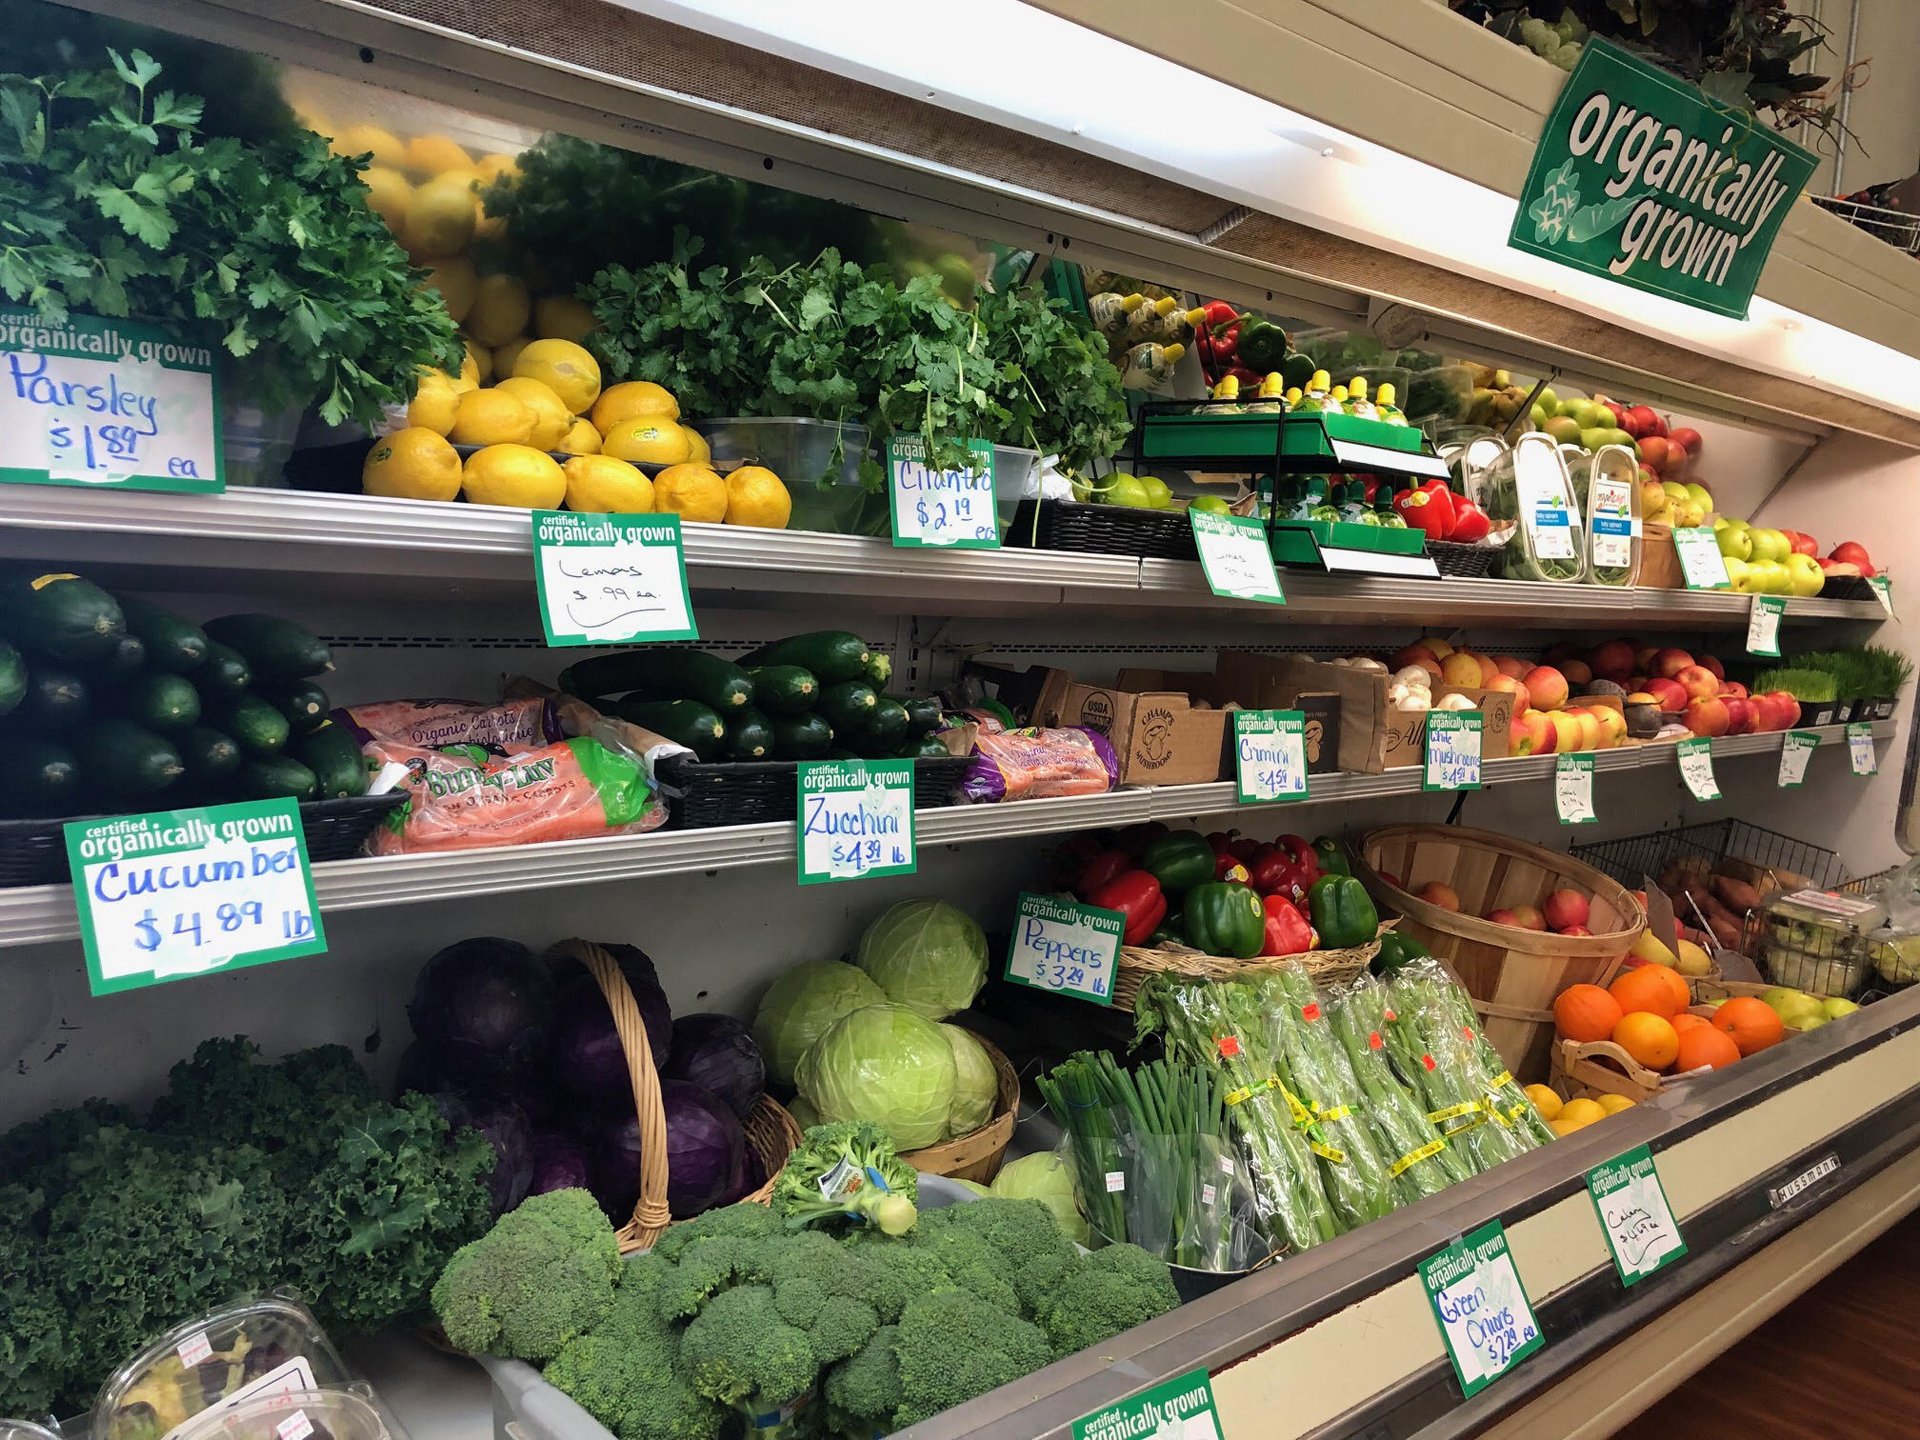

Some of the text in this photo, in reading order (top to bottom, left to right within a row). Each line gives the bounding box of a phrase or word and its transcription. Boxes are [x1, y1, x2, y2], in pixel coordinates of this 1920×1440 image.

[1569, 94, 1788, 249] organically
[1608, 200, 1739, 286] grown
[0, 325, 211, 366] organically grown
[1, 349, 157, 435] Parsley
[895, 436, 923, 446] certified
[168, 457, 198, 478] ea
[543, 515, 578, 526] certified
[1194, 516, 1264, 538] organically grown
[539, 521, 675, 545] organically grown
[975, 526, 996, 540] ea
[1088, 701, 1108, 714] USDA
[412, 711, 516, 746] Organic Carots
[1238, 717, 1302, 734] organically grown
[1430, 716, 1481, 731] organically grown
[808, 764, 838, 775] certified
[1135, 750, 1172, 770] MUSHROOMS
[804, 769, 910, 792] organically grown
[1295, 776, 1304, 790] lb
[86, 818, 148, 838] certified
[804, 797, 898, 836] Zucchini
[80, 814, 293, 861] organically grown
[892, 846, 905, 863] lb
[95, 846, 298, 902] Cucumber
[1027, 896, 1053, 907] certified
[282, 910, 316, 942] lb
[1022, 901, 1120, 932] organically grown
[1024, 917, 1102, 969] Peppers
[1092, 977, 1105, 994] lb
[1592, 1157, 1653, 1195] organically grown
[1427, 1234, 1504, 1290] organically grown
[1427, 1255, 1450, 1274] certified
[1433, 1286, 1486, 1324] Green
[1466, 1306, 1514, 1348] Onions
[1164, 1385, 1208, 1421] grown
[1084, 1408, 1121, 1434] certified
